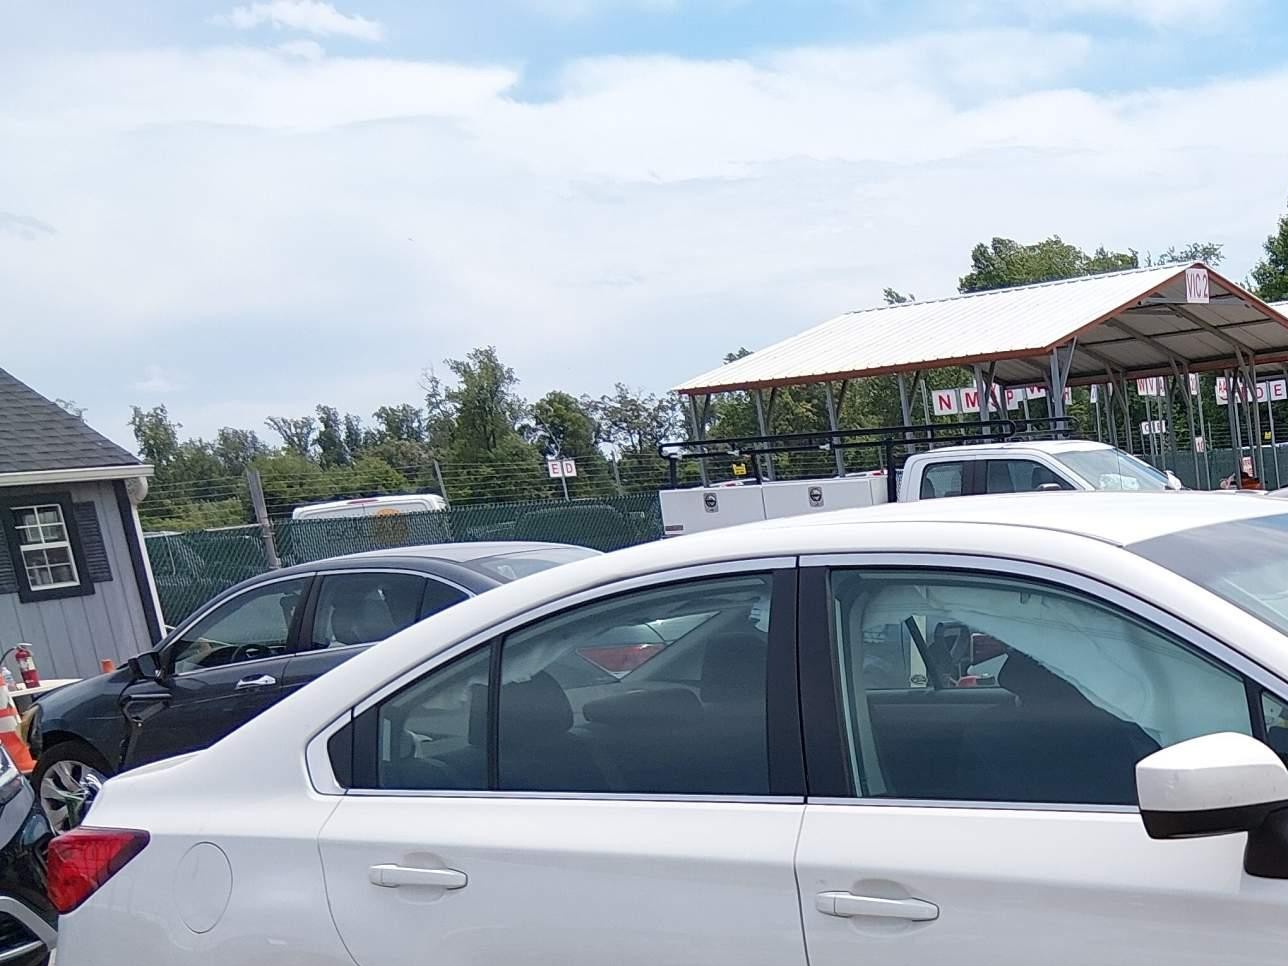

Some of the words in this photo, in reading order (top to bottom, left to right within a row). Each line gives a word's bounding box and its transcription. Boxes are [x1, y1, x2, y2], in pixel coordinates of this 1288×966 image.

[1274, 383, 1283, 397] E
[938, 394, 952, 411] N
[965, 391, 980, 409] M
[551, 463, 560, 474] E
[565, 462, 573, 474] D
